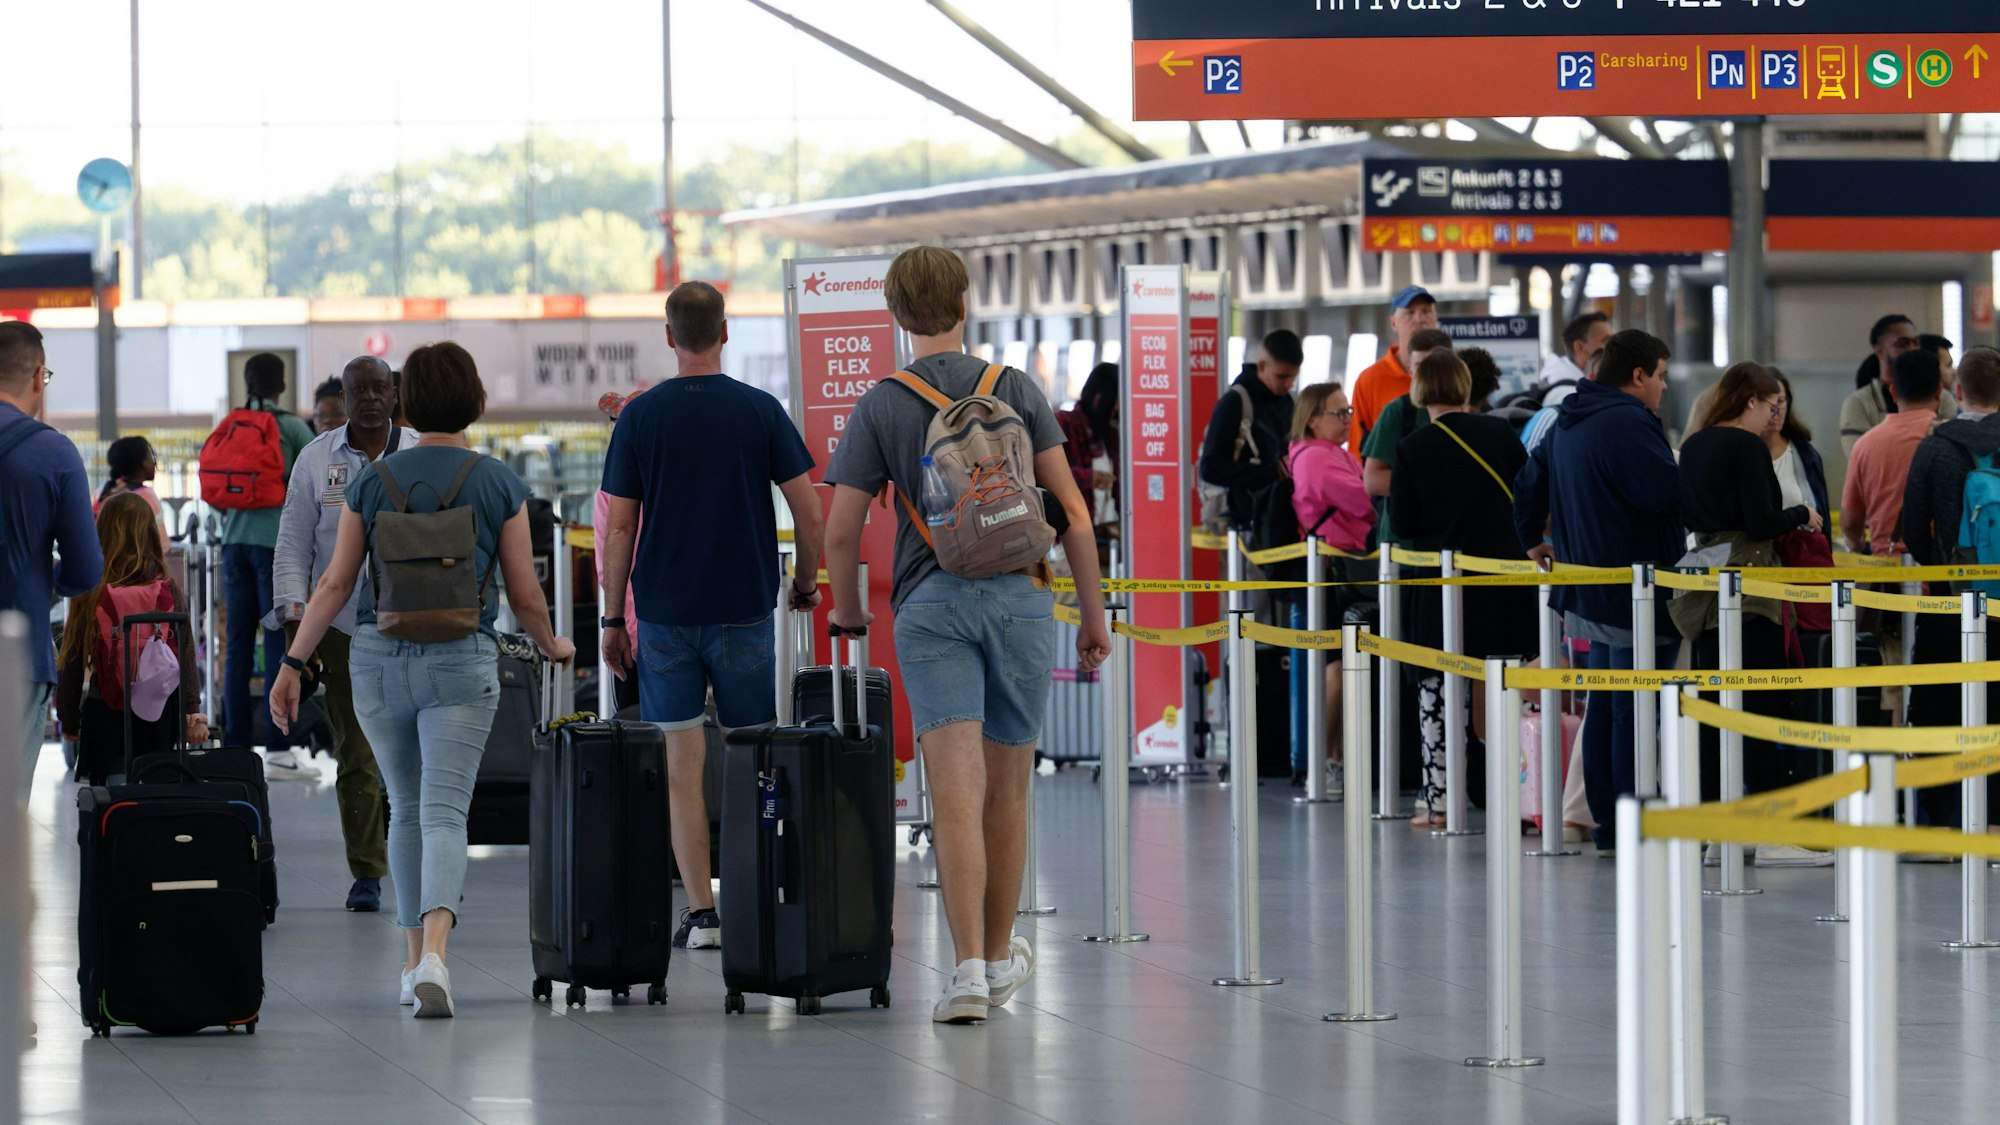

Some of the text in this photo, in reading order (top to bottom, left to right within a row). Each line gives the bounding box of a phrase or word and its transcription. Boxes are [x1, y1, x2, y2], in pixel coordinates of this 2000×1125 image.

[1600, 53, 1688, 71] Carsharing
[1452, 168, 1516, 188] Ankunft
[1518, 168, 1531, 188] 2
[1549, 168, 1563, 188] 3
[1451, 191, 1514, 210] Arrivals
[1518, 191, 1531, 210] 2
[1549, 191, 1563, 210] 3
[824, 336, 872, 354] ECO&
[1142, 336, 1167, 350] ECO&
[828, 358, 870, 375] FLEX
[1143, 355, 1166, 370] FLEX
[1140, 374, 1169, 389] CLASS
[1145, 403, 1165, 418] BAG
[1142, 422, 1168, 437] DROP
[1146, 442, 1165, 457] OFF
[980, 500, 1029, 528] hummel
[1587, 675, 1606, 684] Köln
[1609, 675, 1629, 685] Bonn
[1725, 675, 1803, 685] Köln Bonn Airport
[763, 800, 775, 819] Finn
